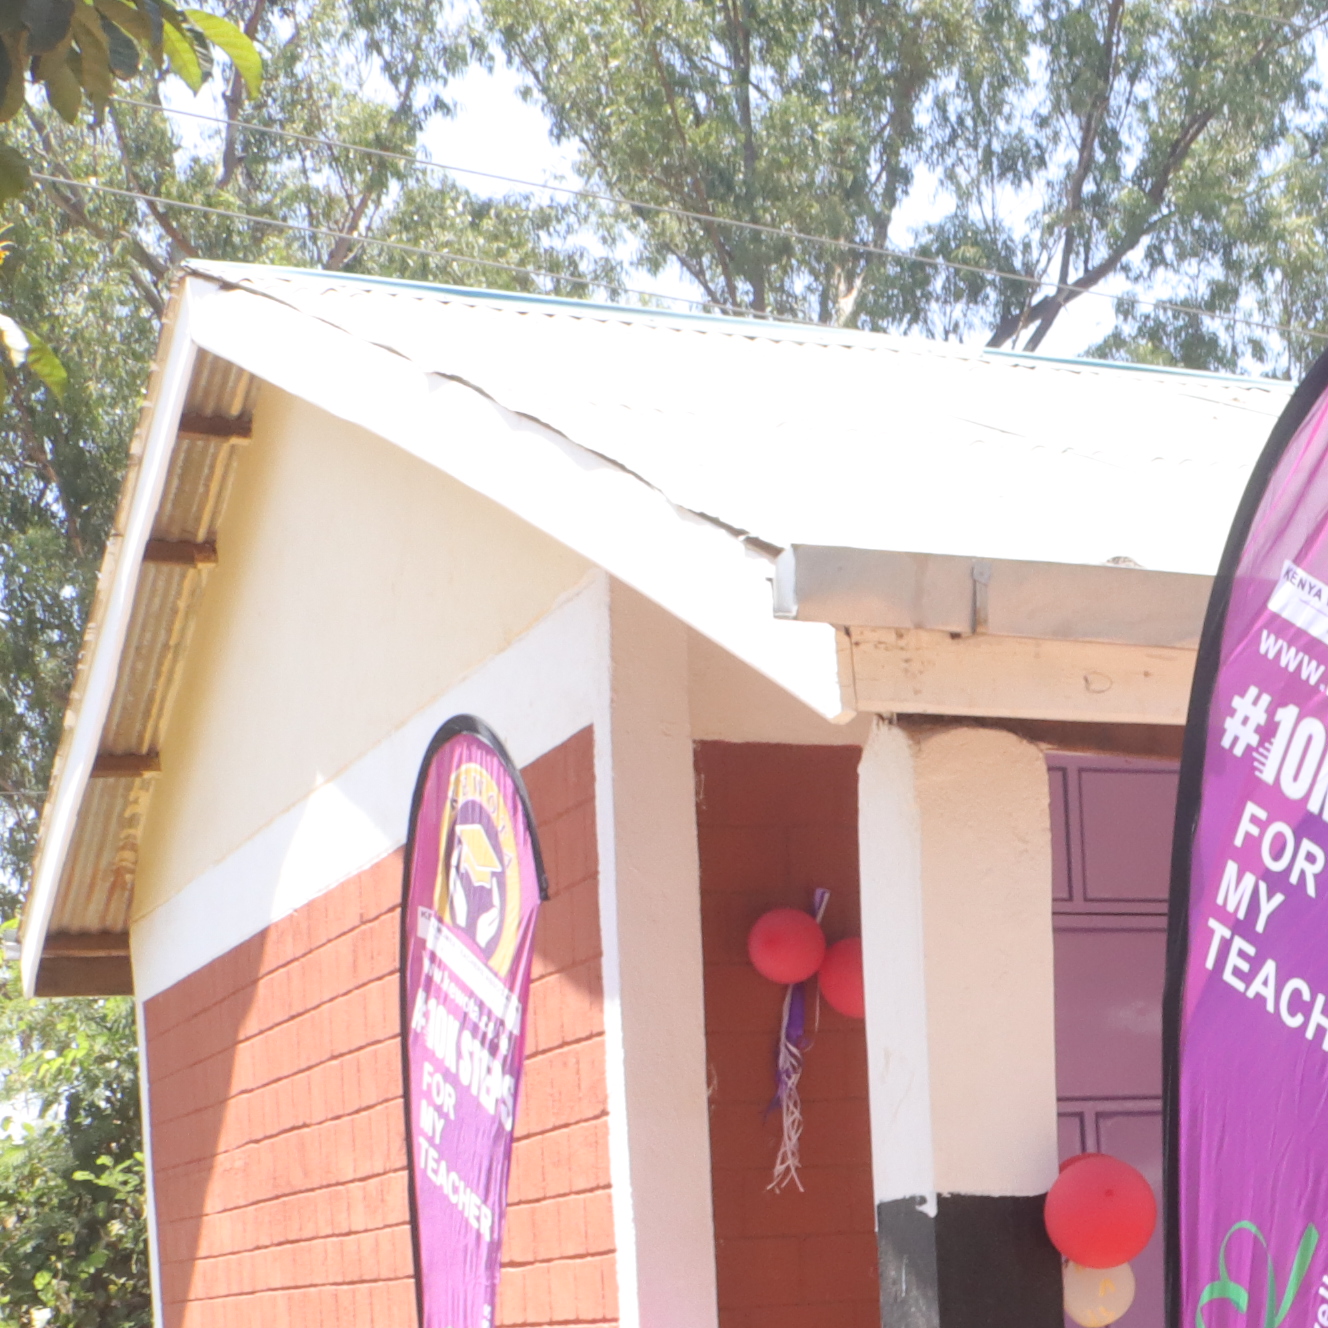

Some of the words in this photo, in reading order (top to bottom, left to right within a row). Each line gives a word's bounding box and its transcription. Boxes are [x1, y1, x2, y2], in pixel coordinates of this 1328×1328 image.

[1283, 567, 1322, 601] KENYA
[1233, 800, 1326, 898] FOR
[1215, 861, 1286, 934] MY
[419, 1098, 445, 1145] MY
[422, 1061, 456, 1121] FOR
[418, 1135, 492, 1242] TEACHER
